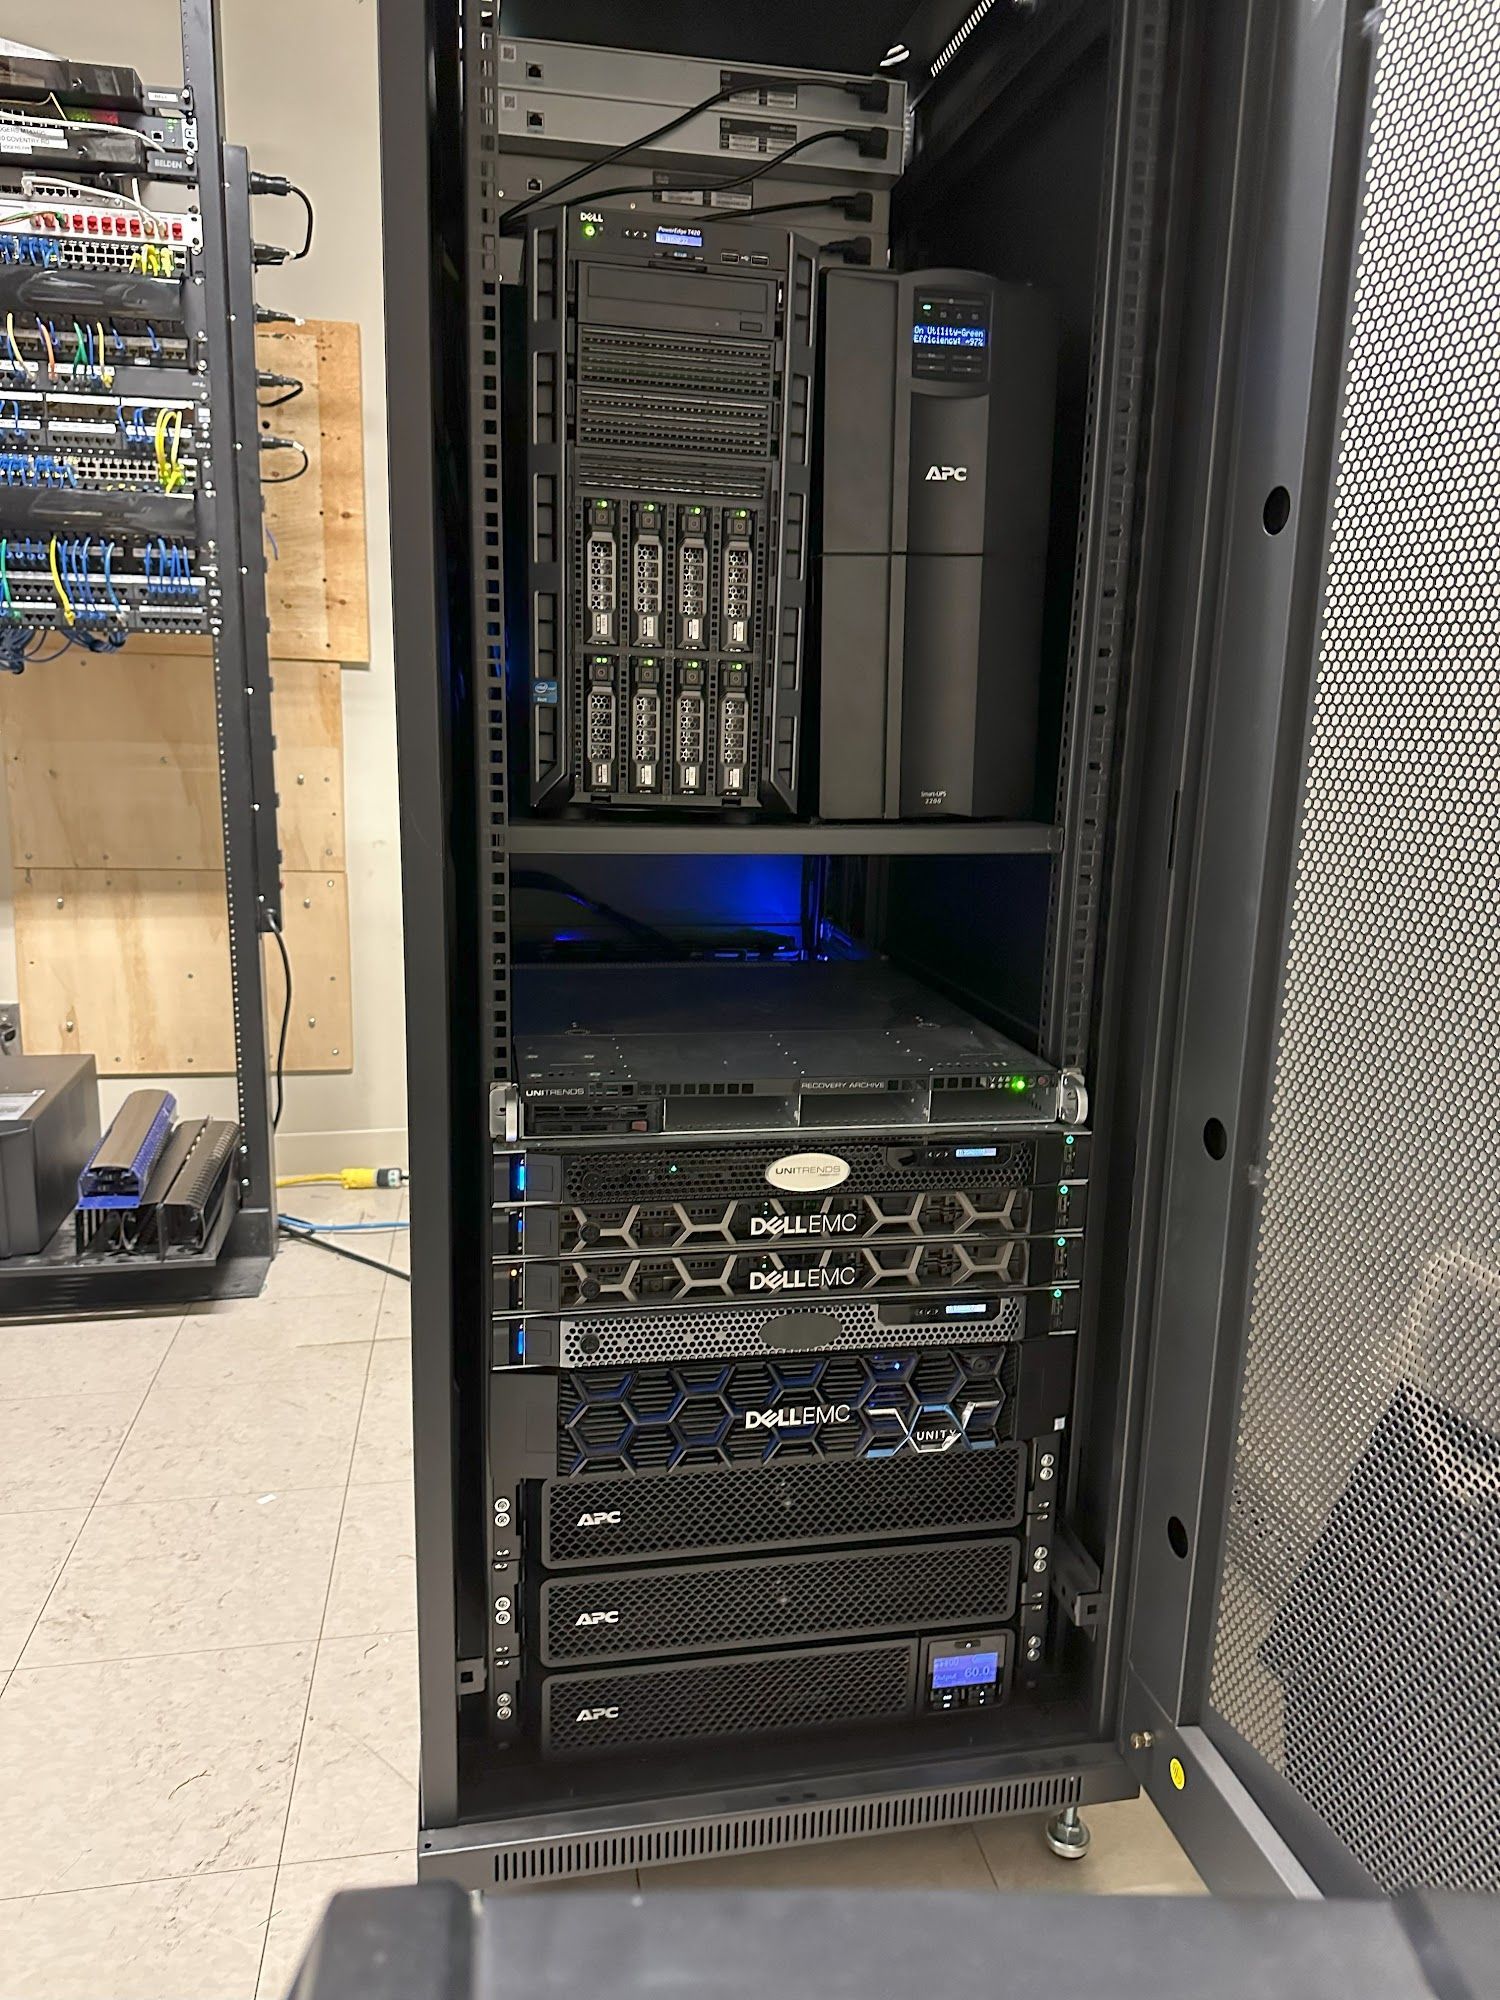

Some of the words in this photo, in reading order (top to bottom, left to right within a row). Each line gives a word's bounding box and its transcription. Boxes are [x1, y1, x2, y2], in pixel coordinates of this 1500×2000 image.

[154, 159, 183, 169] BELDEN
[580, 212, 604, 223] DELL
[687, 228, 701, 236] T420
[914, 326, 924, 334] On
[927, 326, 984, 338] Utility-Green
[925, 465, 967, 482] APC
[849, 1081, 885, 1089] ARCHIVE
[525, 1088, 585, 1097] UNITRENDS
[775, 1165, 841, 1175] UNITRENDS
[916, 1429, 957, 1441] UNITY
[576, 1510, 622, 1527] APC
[575, 1610, 620, 1627] APC
[964, 1666, 990, 1678] 60.0
[575, 1706, 620, 1723] APC
